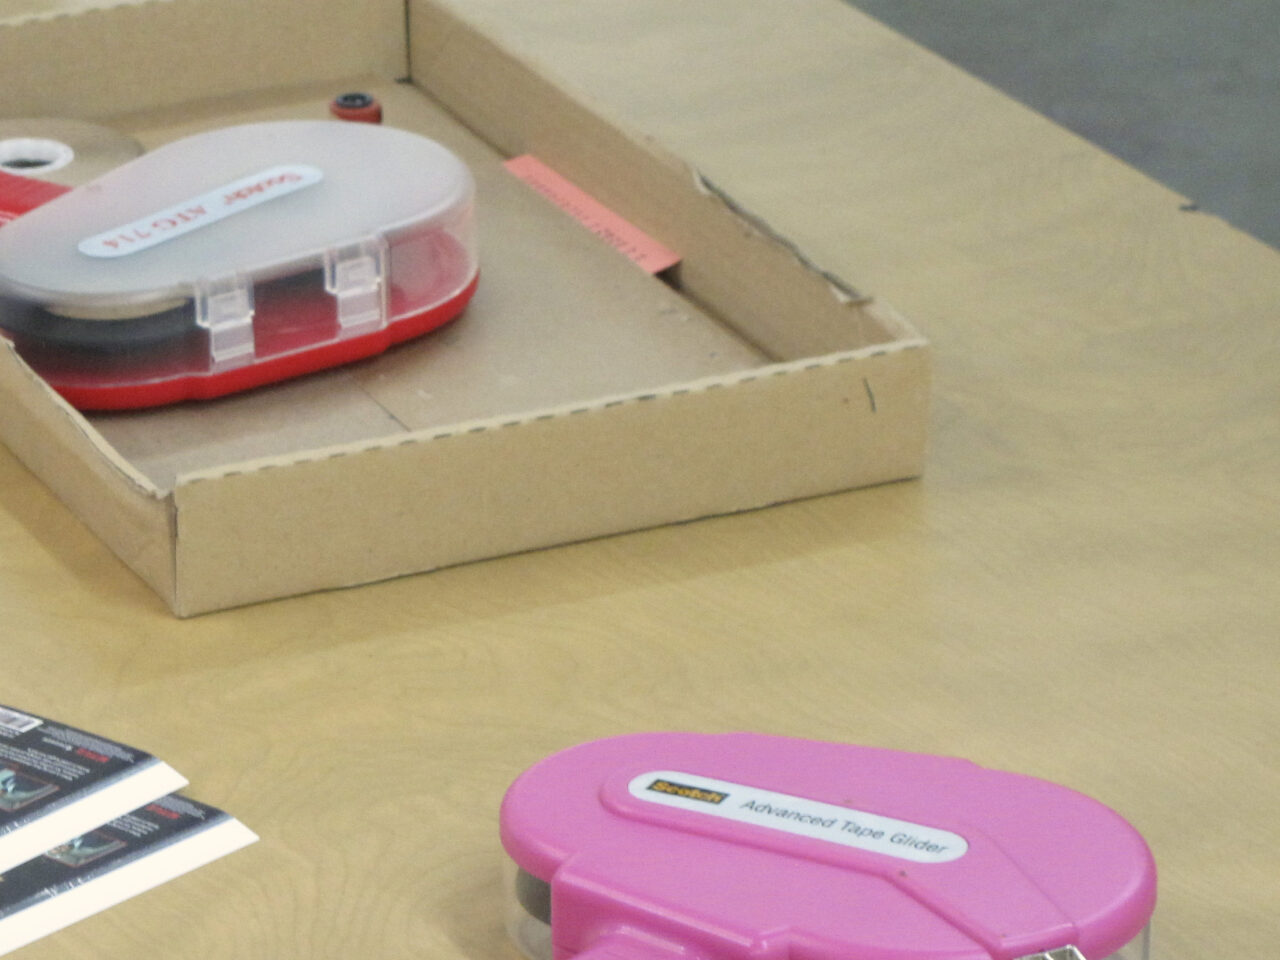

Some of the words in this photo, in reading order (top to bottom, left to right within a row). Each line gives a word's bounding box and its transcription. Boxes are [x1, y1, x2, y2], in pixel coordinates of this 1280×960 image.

[650, 780, 723, 803] Scotch
[739, 800, 837, 828] Advanced
[840, 819, 885, 840] Tape
[889, 832, 948, 855] Glider
